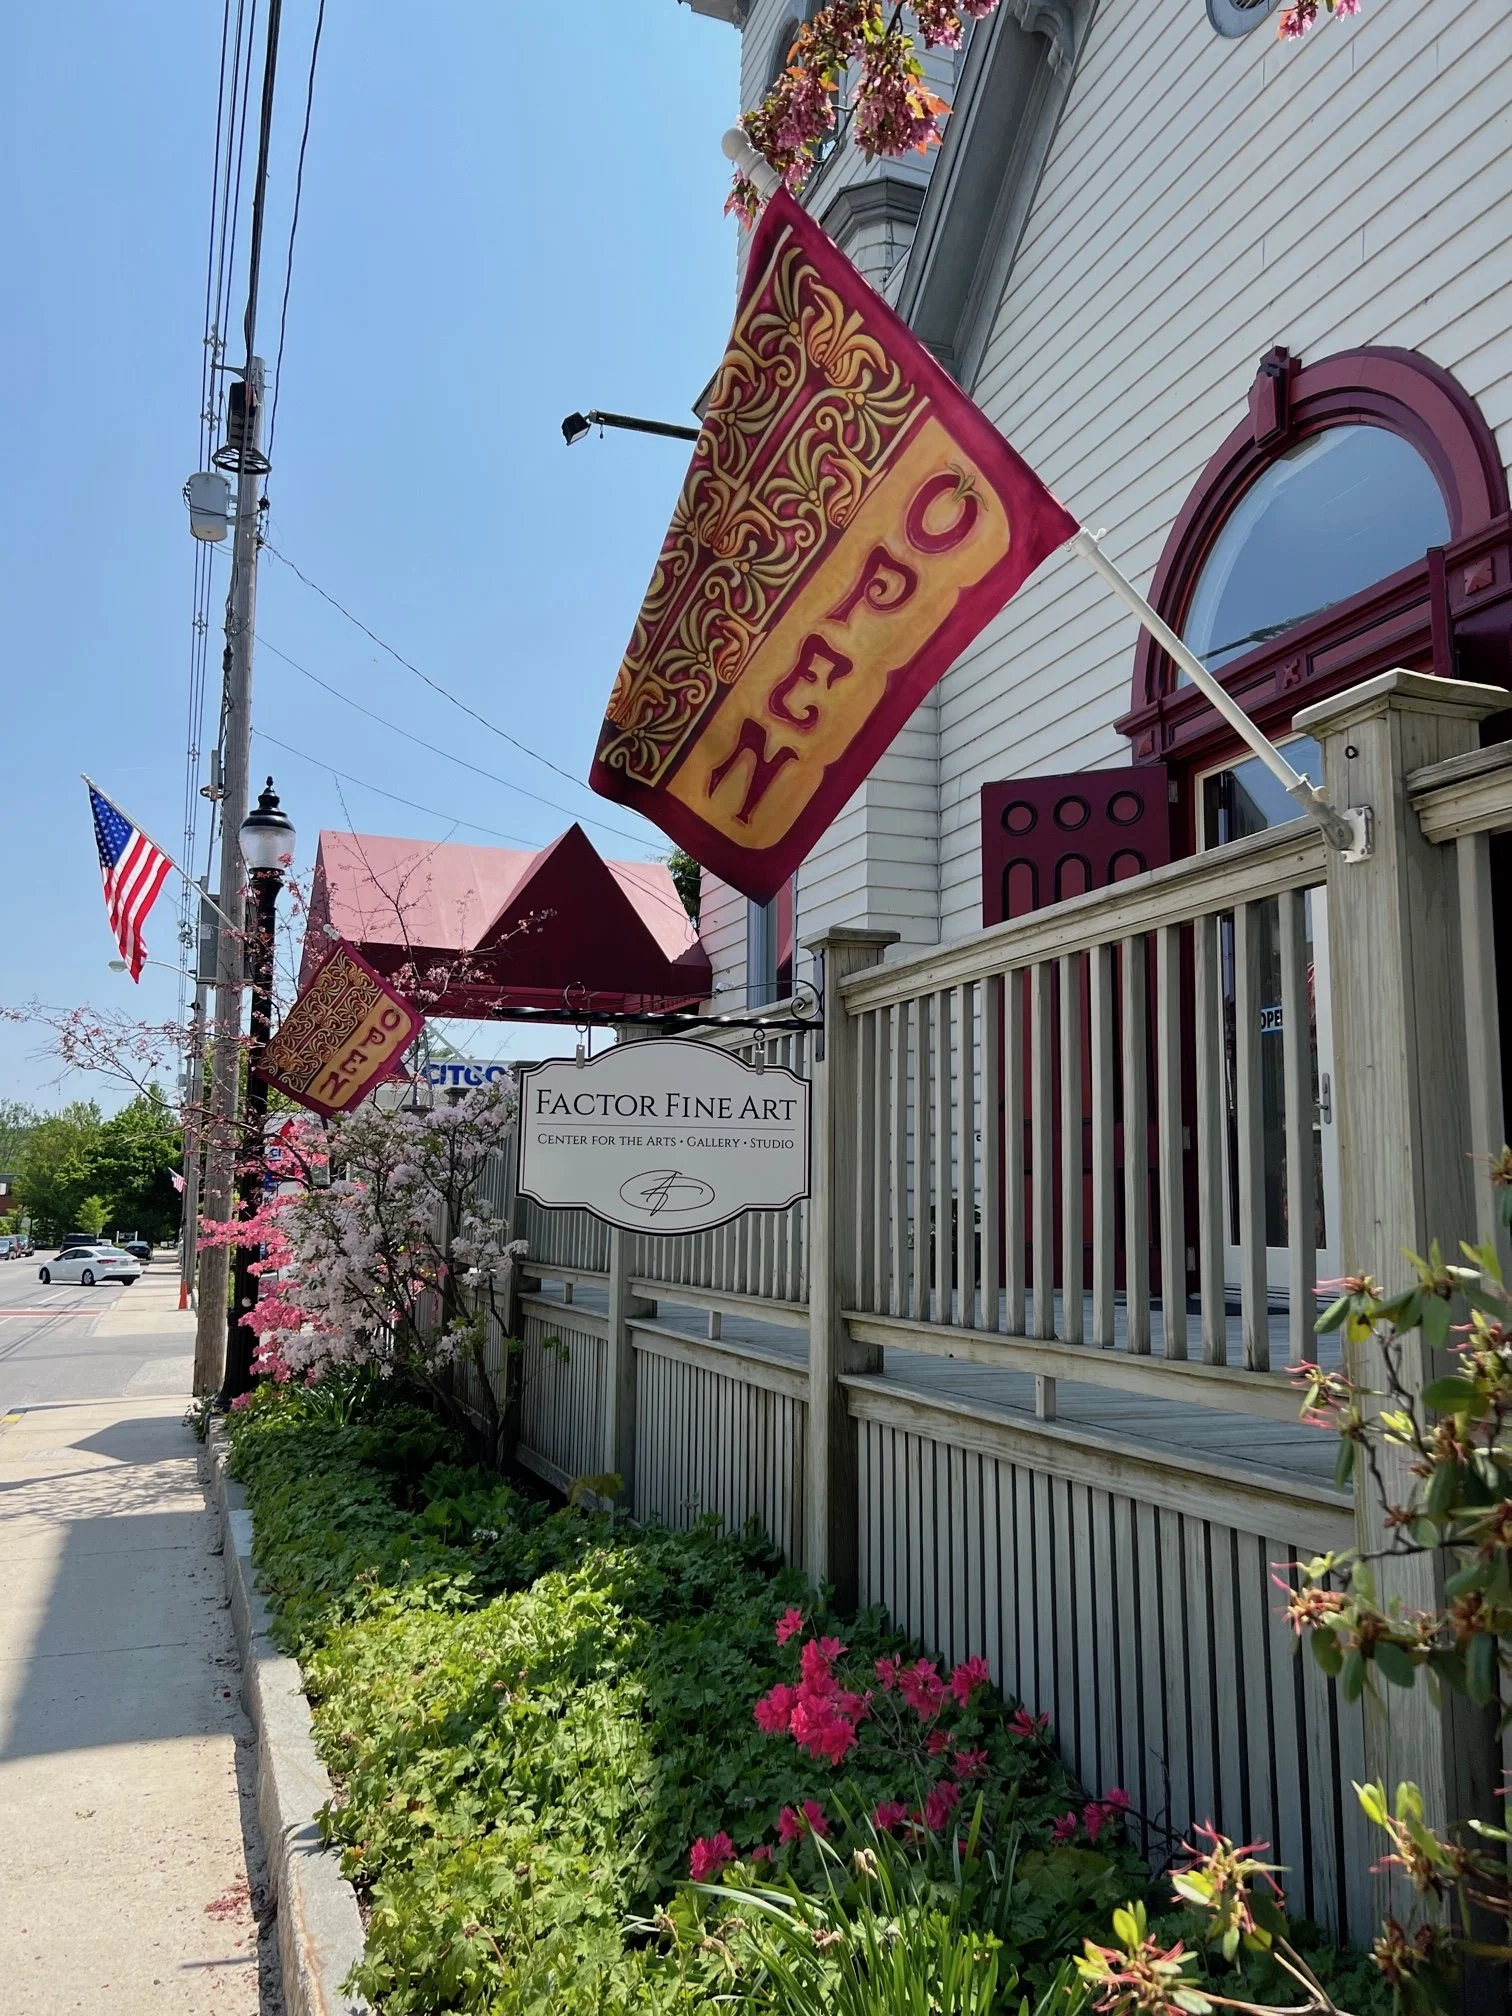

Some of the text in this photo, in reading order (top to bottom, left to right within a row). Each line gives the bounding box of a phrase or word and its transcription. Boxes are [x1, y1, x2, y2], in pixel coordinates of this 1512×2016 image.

[708, 468, 980, 826] OPEN
[319, 1007, 401, 1100] OPEN
[535, 1088, 798, 1121] FACTOR FINE ART
[537, 1133, 795, 1150] CENTER FOR THE ARTS GALLERY STUDIO
